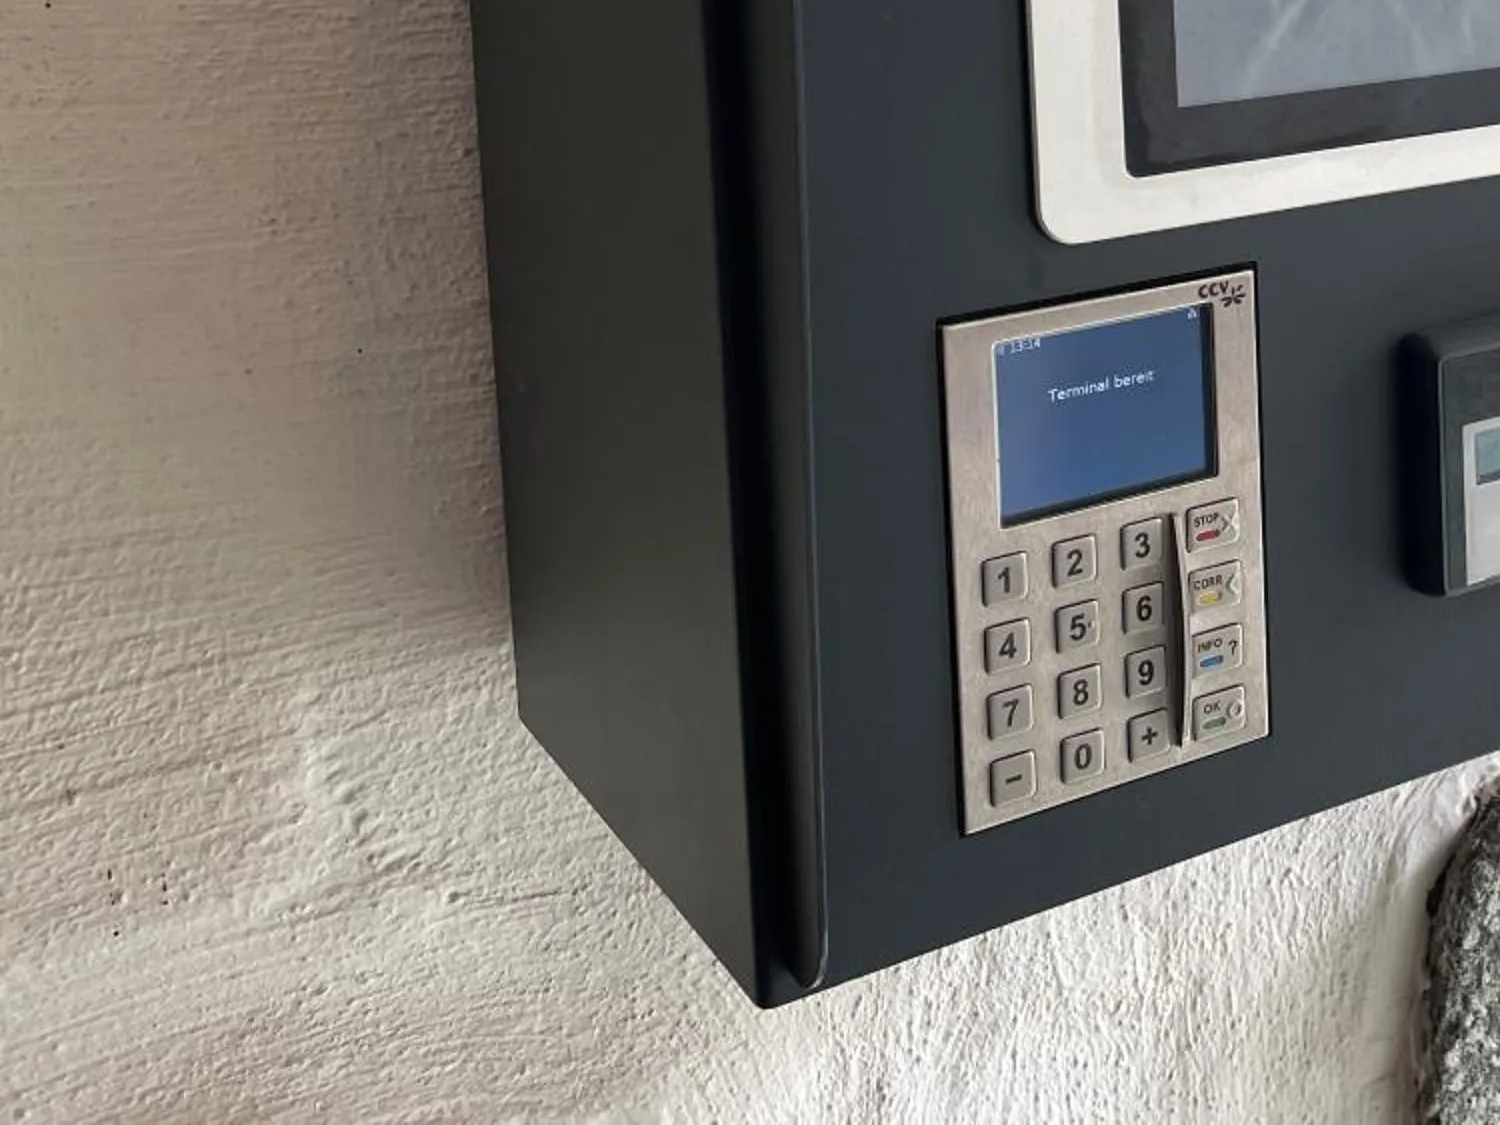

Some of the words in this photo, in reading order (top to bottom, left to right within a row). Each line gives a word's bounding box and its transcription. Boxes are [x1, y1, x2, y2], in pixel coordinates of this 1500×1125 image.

[1198, 280, 1229, 299] CCV
[1048, 375, 1110, 403] Terminal
[1113, 370, 1155, 388] bereit
[1194, 512, 1220, 528] STOP
[1134, 532, 1150, 557] 3
[1067, 549, 1083, 576] 2
[997, 567, 1010, 593] 1
[1193, 574, 1223, 591] CORR
[1136, 596, 1152, 621] 6
[1069, 613, 1086, 641] 5
[998, 633, 1017, 658] 4
[1198, 638, 1222, 654] INFO
[1138, 660, 1154, 685] 9
[1073, 679, 1089, 705] 8
[1002, 700, 1019, 727] 7
[1204, 701, 1221, 715] OK
[1074, 743, 1092, 770] 0
